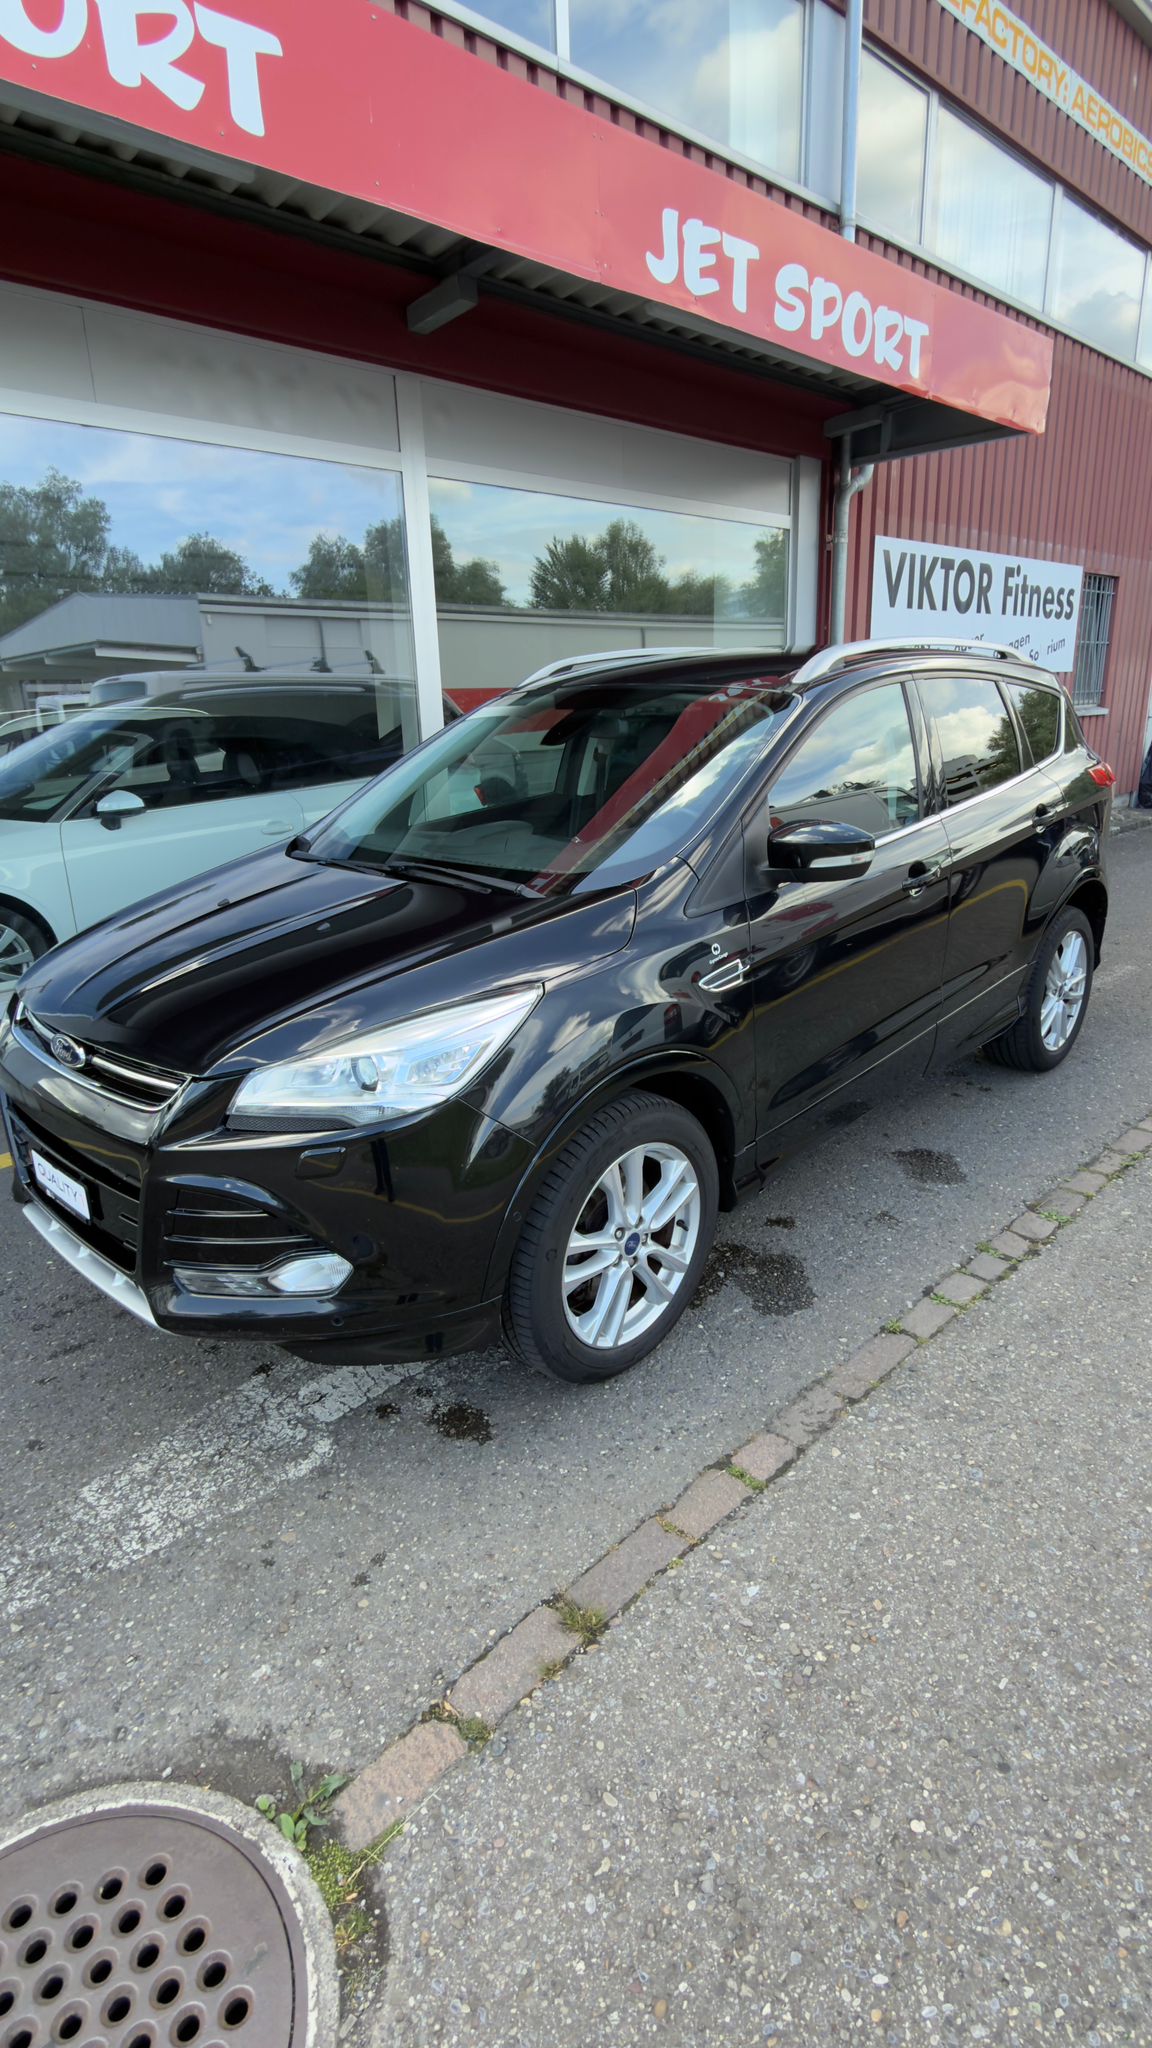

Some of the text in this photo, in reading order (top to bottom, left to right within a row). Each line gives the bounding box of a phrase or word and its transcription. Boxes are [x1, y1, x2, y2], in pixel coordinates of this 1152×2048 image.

[950, 0, 1069, 101] FACTORY:
[646, 208, 930, 379] JET SPORT
[883, 549, 1075, 620] VIKTOR Fitness
